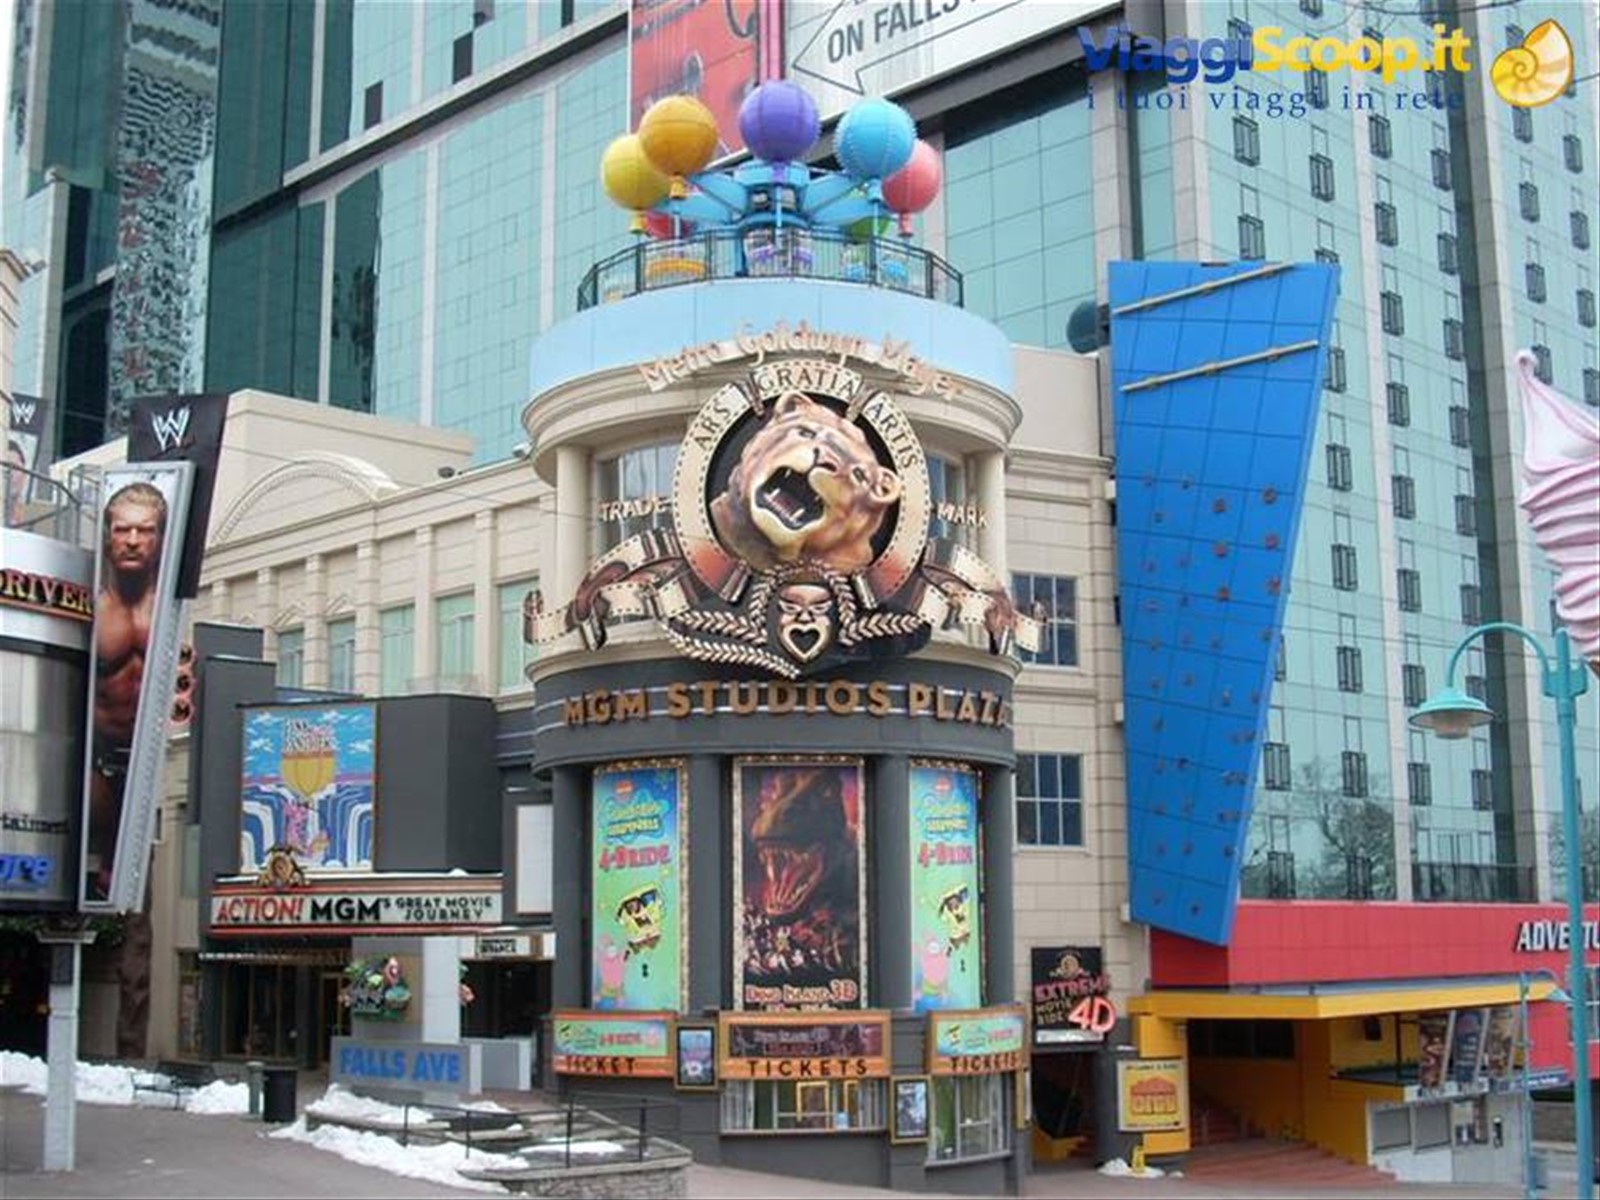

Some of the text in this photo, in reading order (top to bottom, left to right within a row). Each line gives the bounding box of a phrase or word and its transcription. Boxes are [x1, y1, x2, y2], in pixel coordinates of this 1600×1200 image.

[827, 19, 864, 63] ON
[690, 367, 920, 471] ARS GRATIA ARTIS
[600, 496, 669, 523] TRADE
[935, 501, 989, 529] MARK
[563, 686, 649, 726] MGM
[665, 679, 894, 718] STUDIOS
[216, 896, 305, 922] ACTION!
[395, 897, 441, 910] GREAT
[445, 896, 493, 909] MOVIE
[404, 908, 484, 921] JOURNEY
[1068, 996, 1117, 1034] 4D
[340, 1046, 463, 1083] FALLS AVE
[746, 1058, 869, 1078] TICKETS
